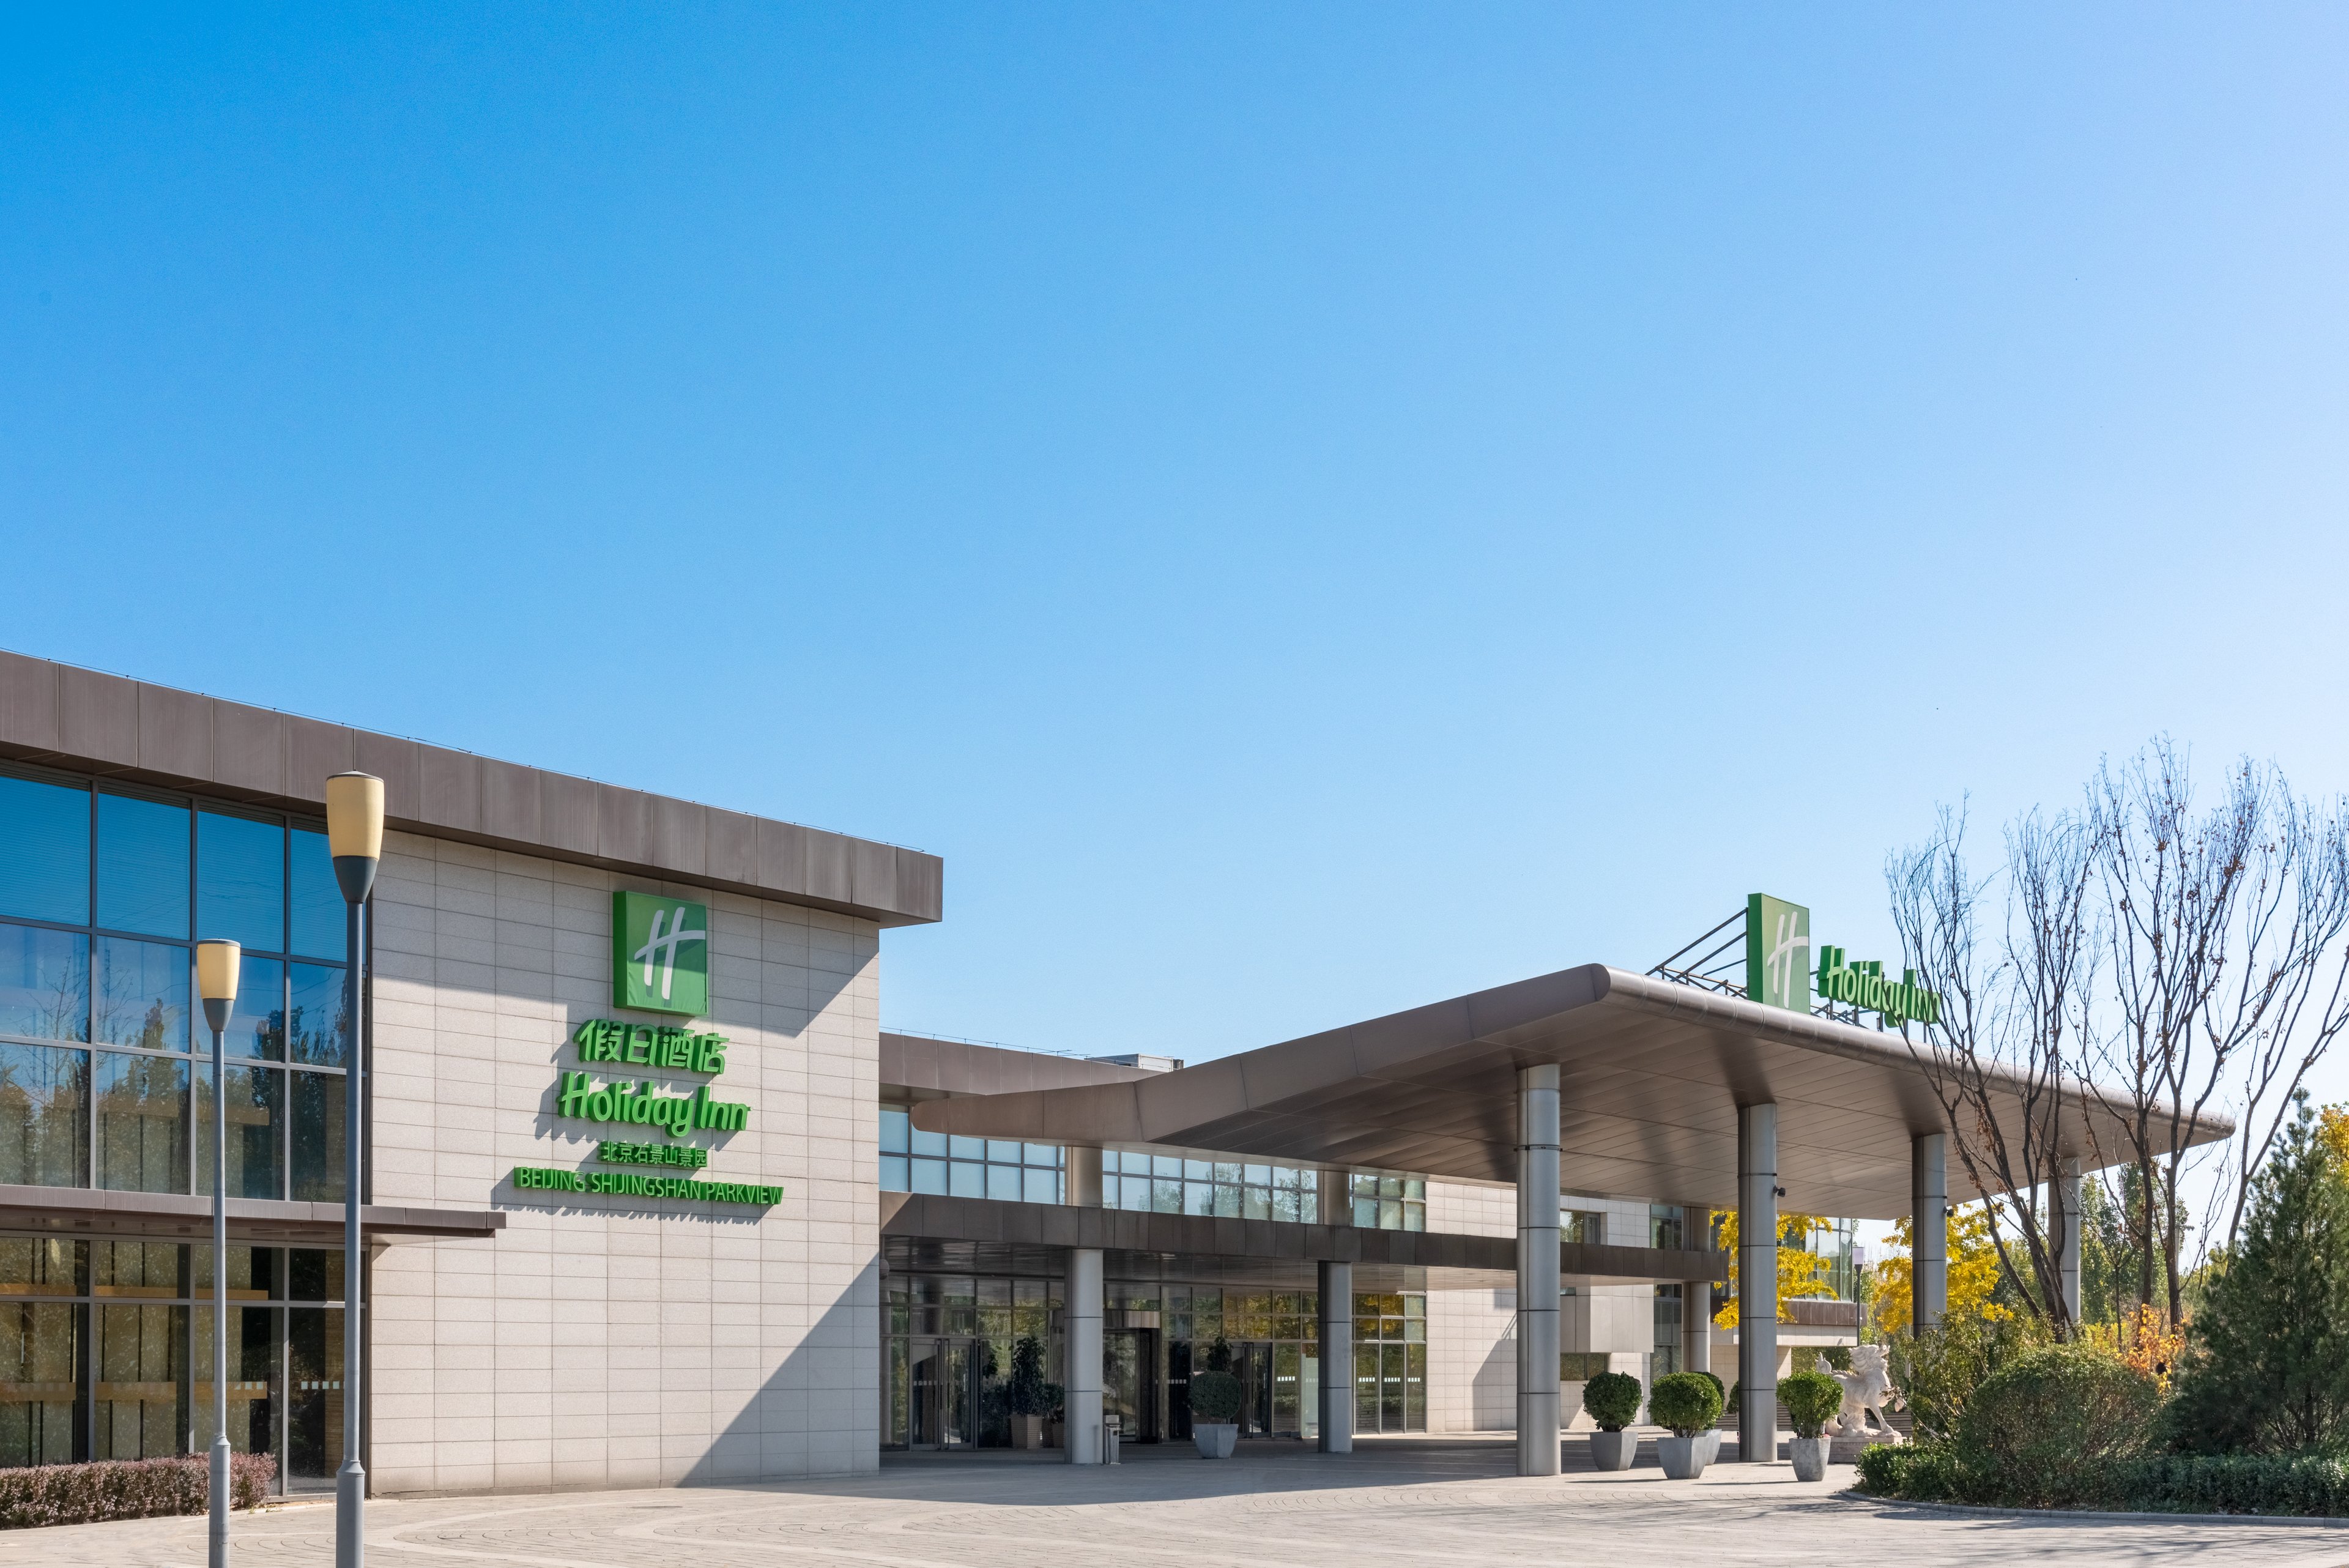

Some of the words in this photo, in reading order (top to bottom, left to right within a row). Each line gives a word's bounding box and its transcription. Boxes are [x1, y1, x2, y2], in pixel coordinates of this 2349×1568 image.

[1823, 945, 1908, 1028] Holiday
[1909, 970, 1941, 1024] Inn
[576, 1019, 730, 1074] 假日酒店
[558, 1072, 696, 1137] Holiday
[697, 1086, 749, 1131] Inn
[598, 1141, 708, 1167] 北京石景山景园
[518, 1167, 585, 1192] BEIJING
[588, 1172, 701, 1200] SHIJINGSHAN
[703, 1181, 784, 1205] PARKVIEW
